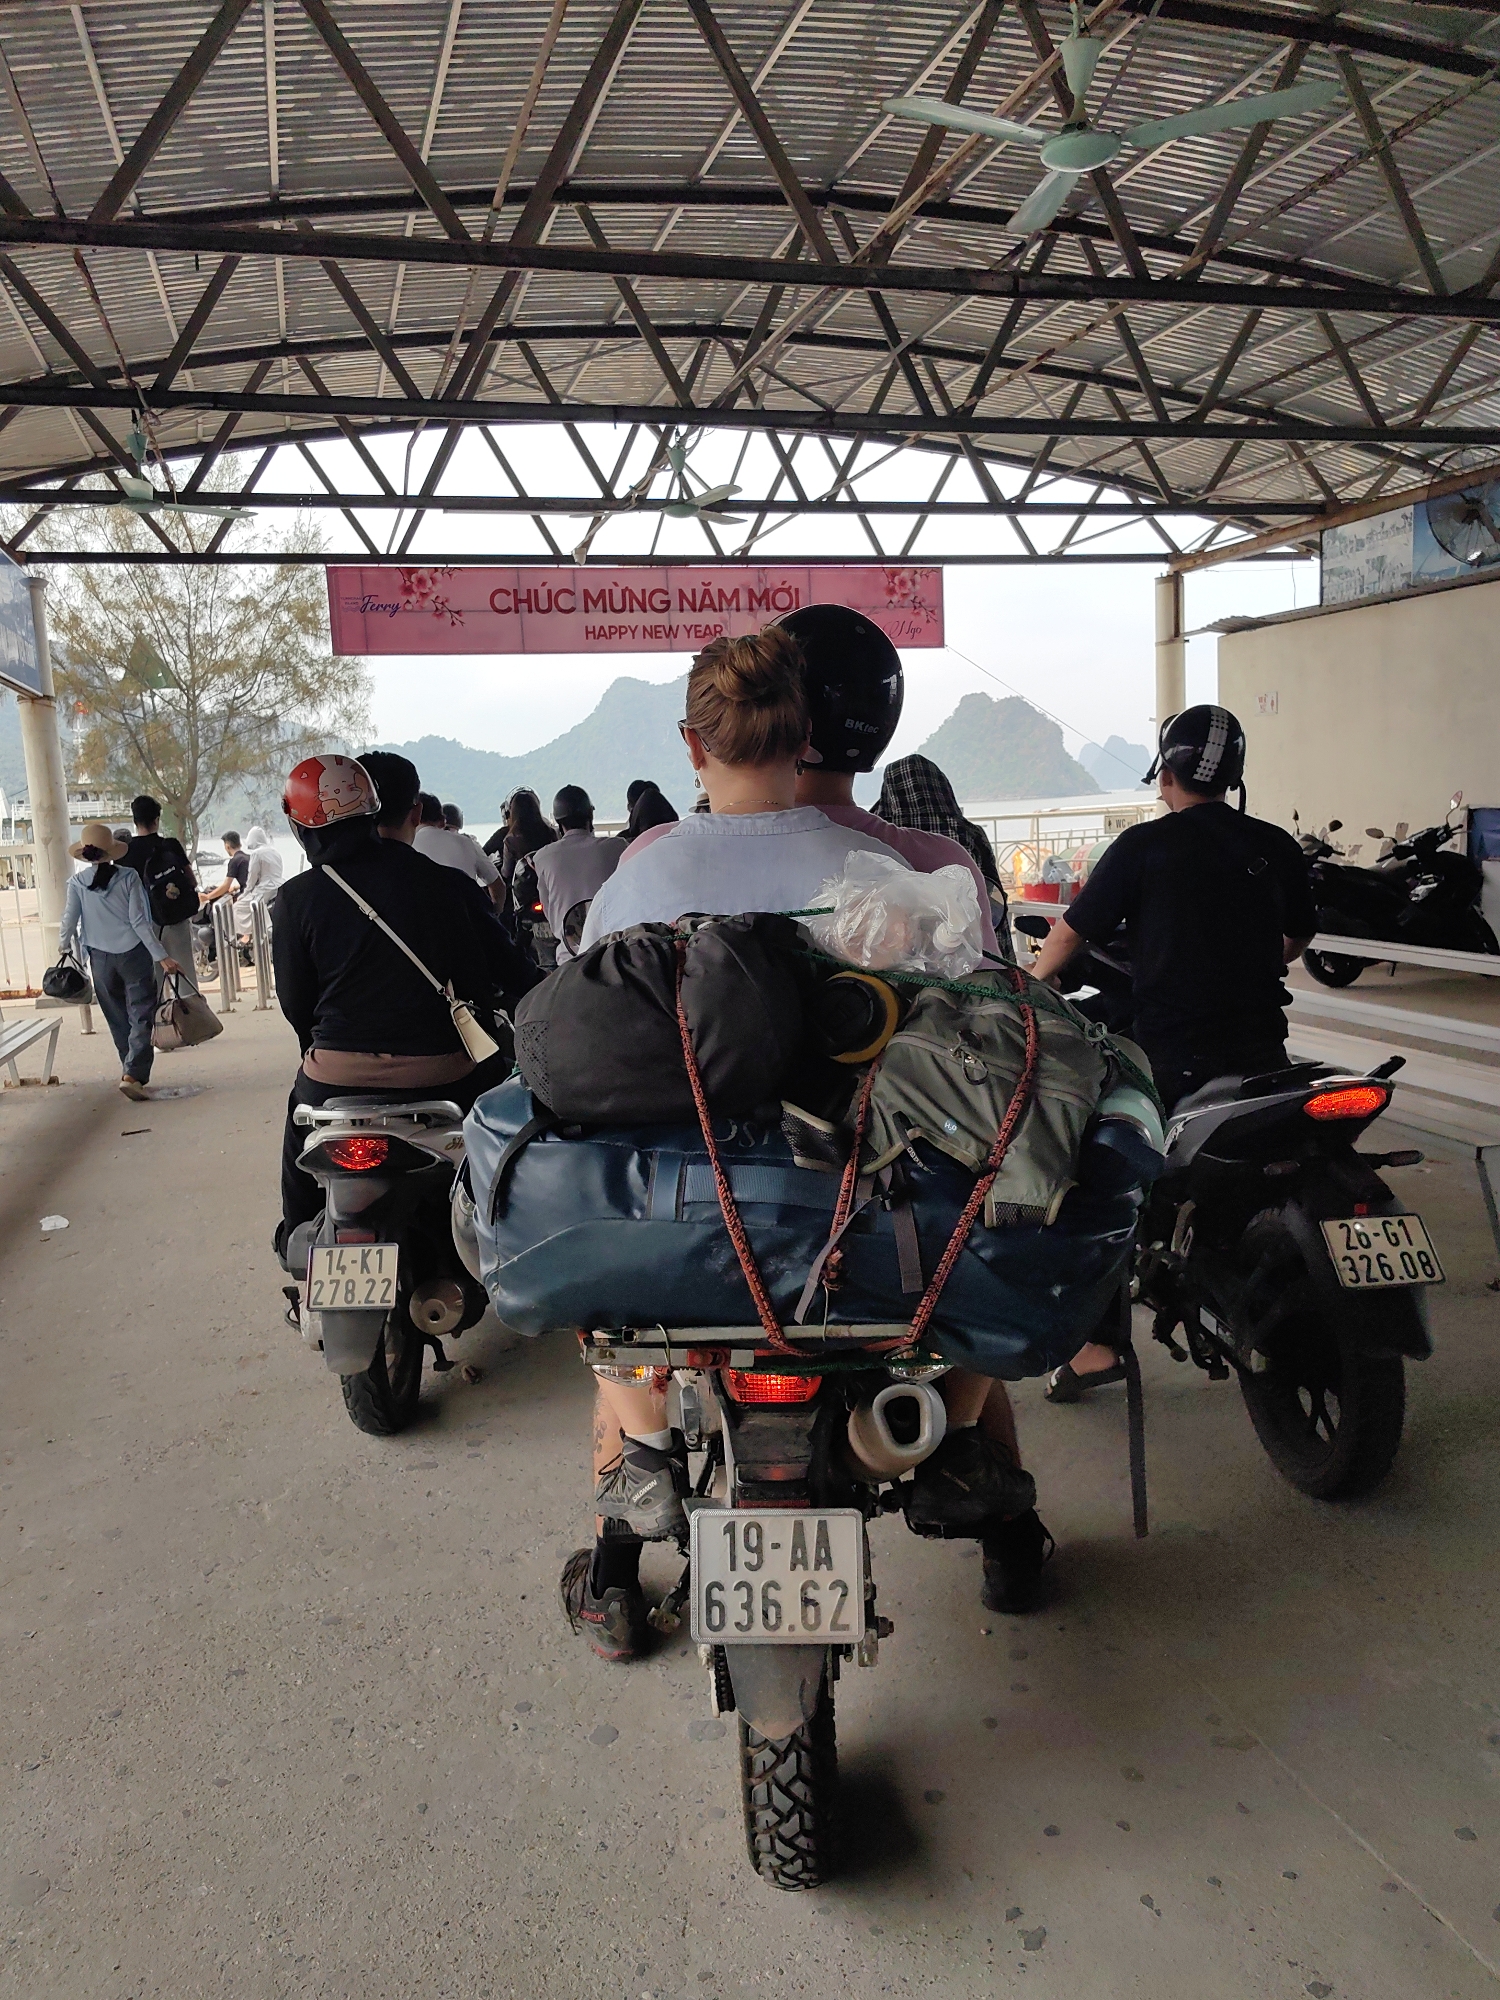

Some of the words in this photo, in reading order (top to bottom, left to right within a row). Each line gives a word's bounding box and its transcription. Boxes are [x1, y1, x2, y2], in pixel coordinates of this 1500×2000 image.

[360, 594, 401, 618] Ferry
[489, 581, 577, 615] CHÚC
[582, 581, 672, 614] MỪNG
[678, 581, 741, 613] NĂM
[747, 580, 800, 613] MỚI
[585, 625, 639, 640] HAPPY
[642, 624, 680, 640] NEW
[683, 624, 724, 640] YEAR
[1115, 818, 1126, 829] WC
[1338, 1219, 1413, 1251] 26-G1
[326, 1248, 384, 1275] 14-K1
[1342, 1250, 1436, 1284] 326.08
[312, 1278, 392, 1306] 278.22
[722, 1520, 833, 1571] 19-AA
[705, 1579, 850, 1632] 636.62
